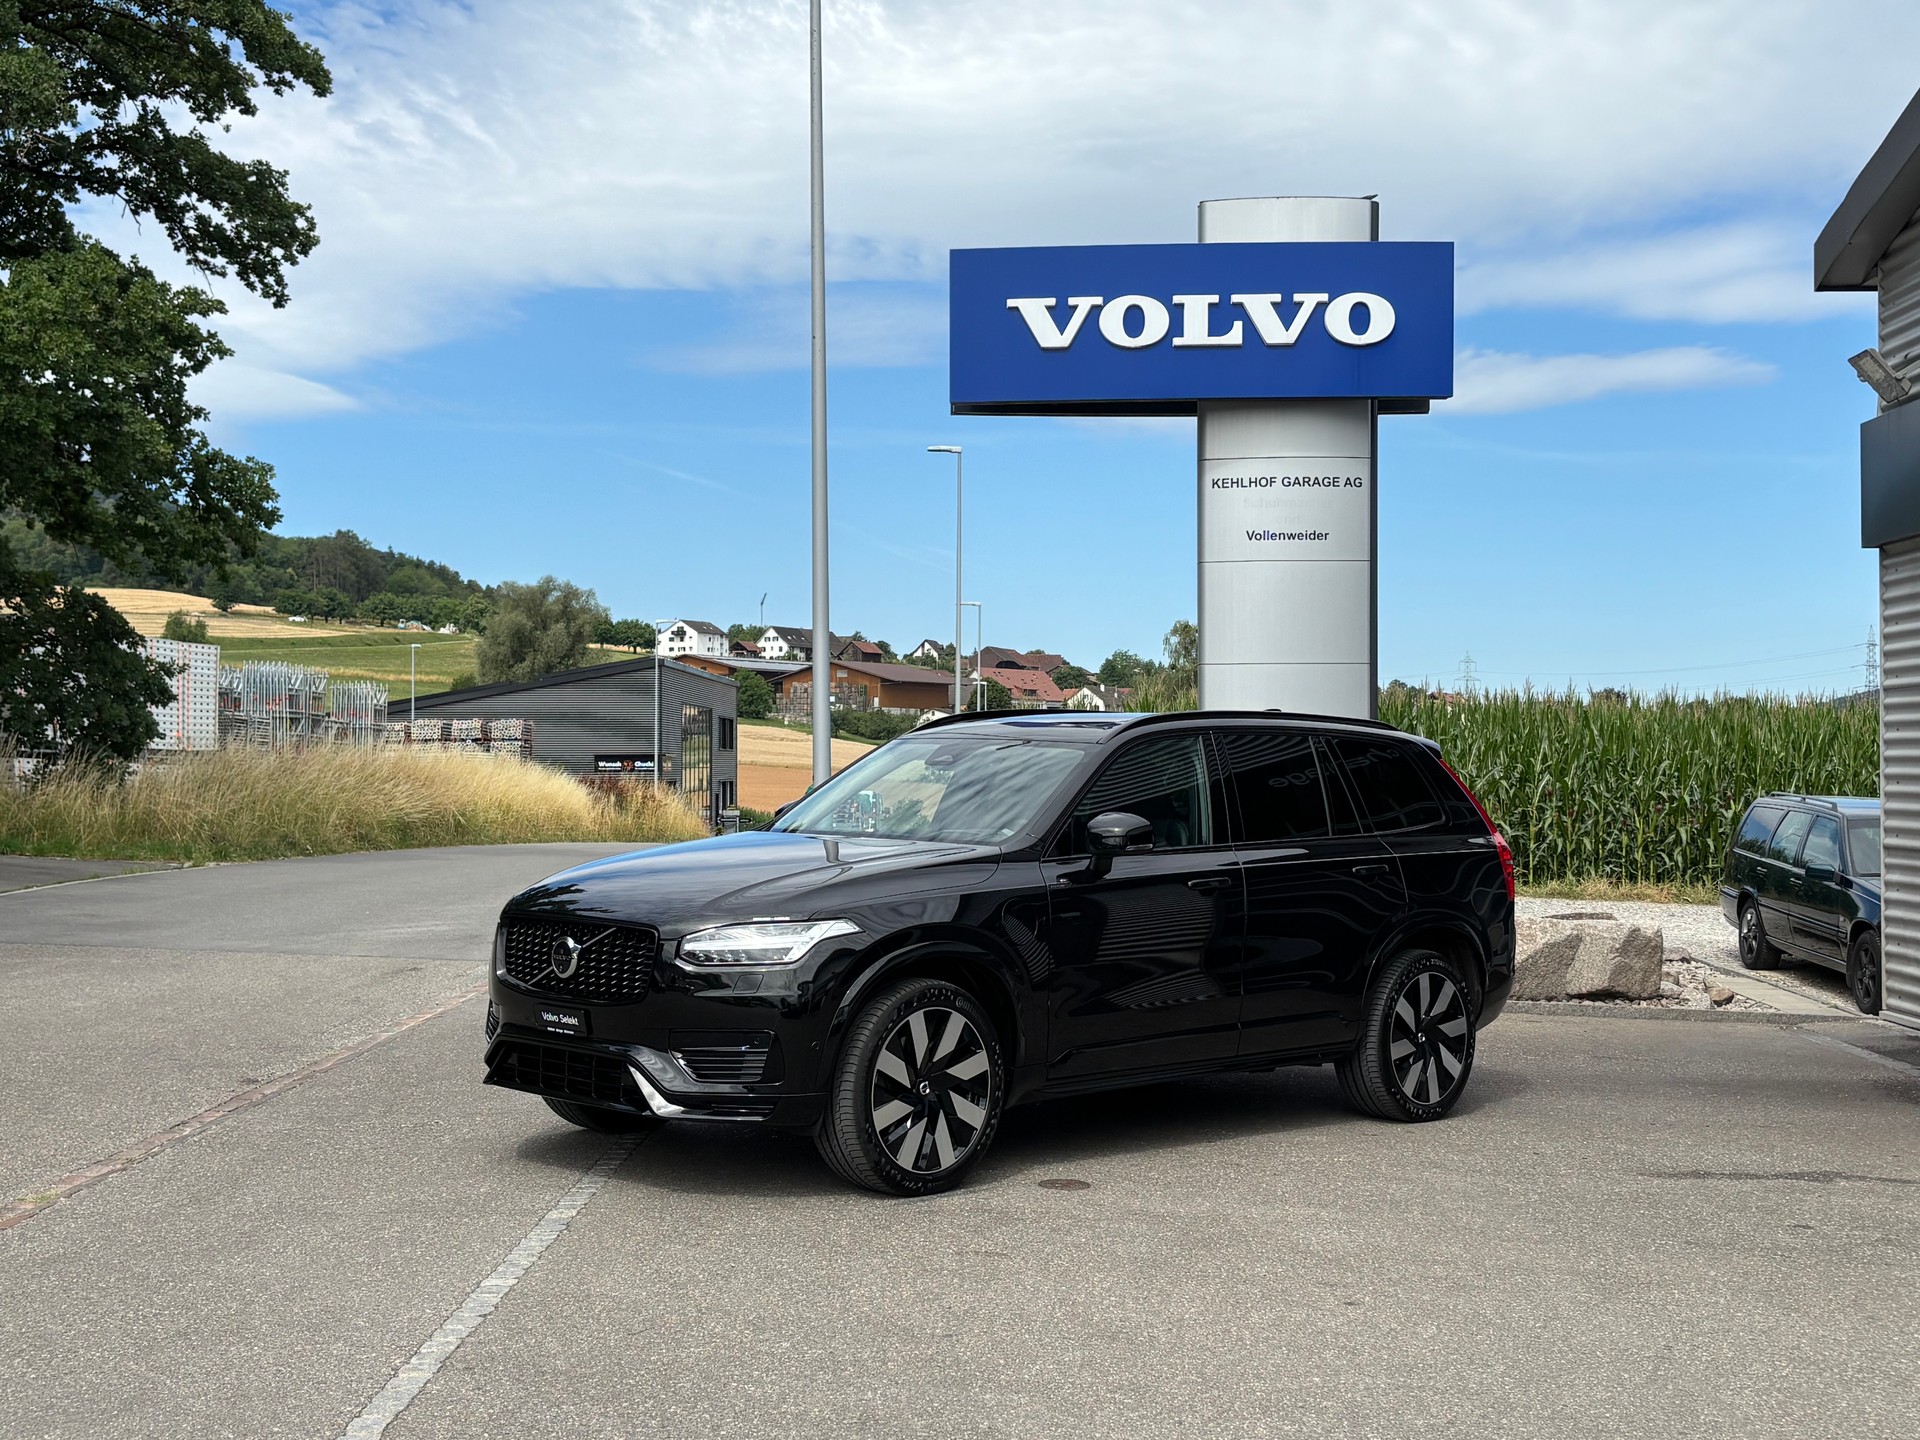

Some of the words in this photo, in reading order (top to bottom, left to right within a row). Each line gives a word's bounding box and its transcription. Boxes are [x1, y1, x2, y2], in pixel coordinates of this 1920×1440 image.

[1006, 291, 1397, 350] VOLVO
[1211, 476, 1277, 489] KEHLHOF
[1281, 476, 1340, 488] GARAGE
[1343, 476, 1363, 488] AG
[1246, 530, 1330, 541] Vollenweider
[541, 1011, 559, 1022] Volvo
[559, 1014, 579, 1026] Selekt
